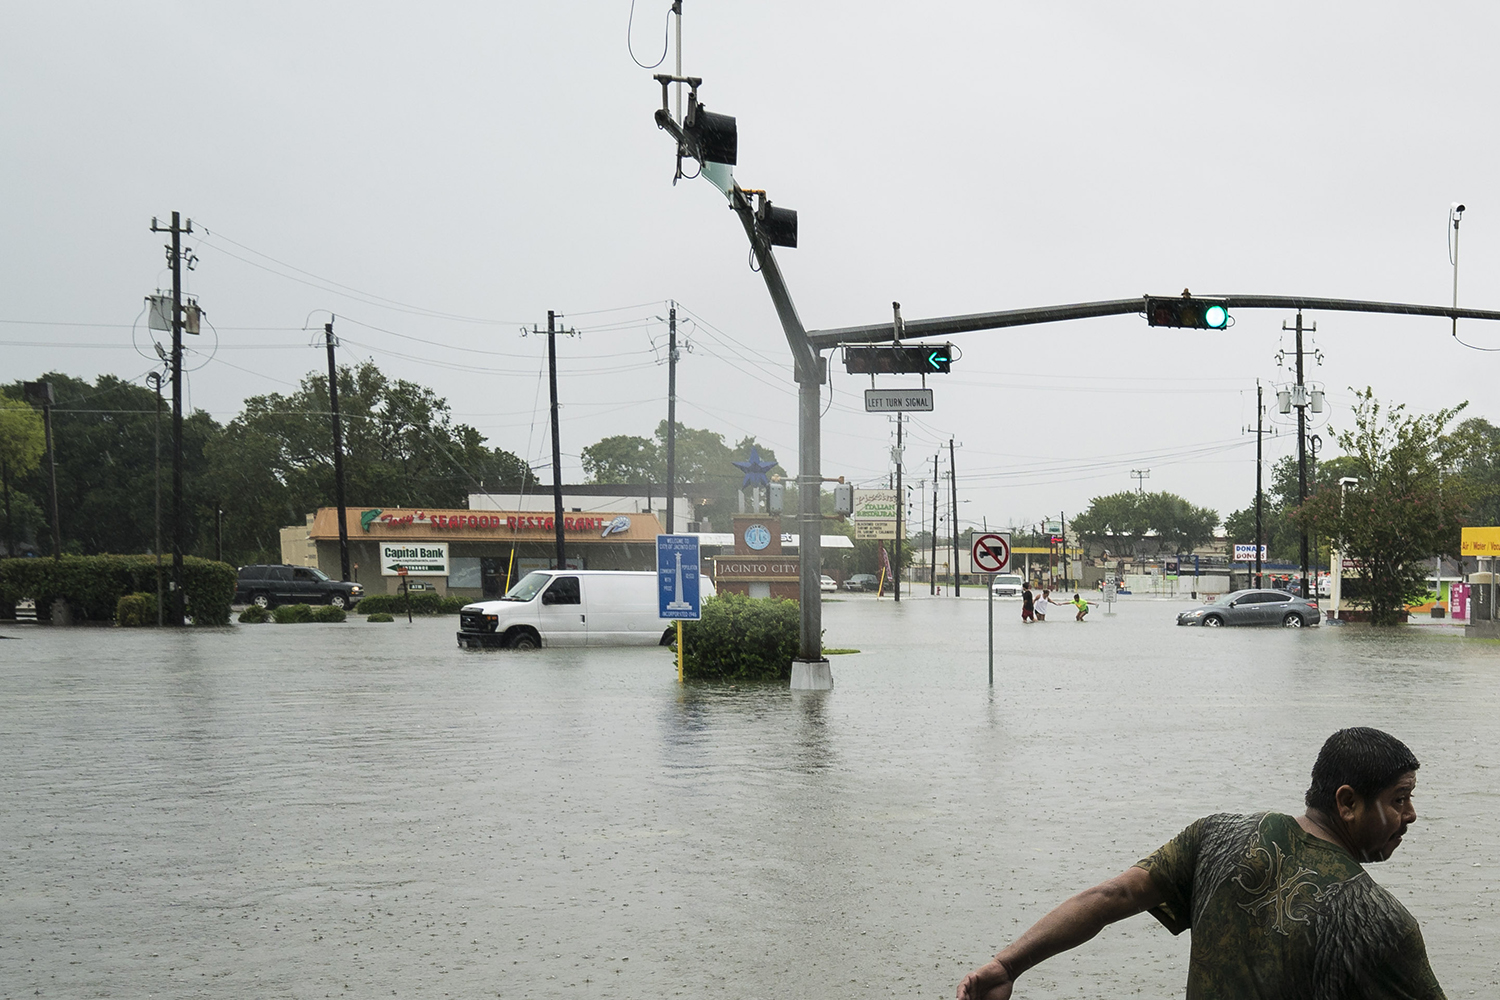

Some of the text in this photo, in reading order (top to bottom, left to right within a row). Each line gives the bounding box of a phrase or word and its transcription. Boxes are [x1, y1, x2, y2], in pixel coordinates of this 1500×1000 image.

[868, 397, 929, 407] LEFT TURN SIGNAL
[430, 514, 500, 530] SEAFOOD
[507, 515, 604, 531] RESTARANT
[1473, 541, 1486, 550] Water
[385, 546, 444, 560] Capital Bank
[720, 564, 797, 574] JACINTO CITY
